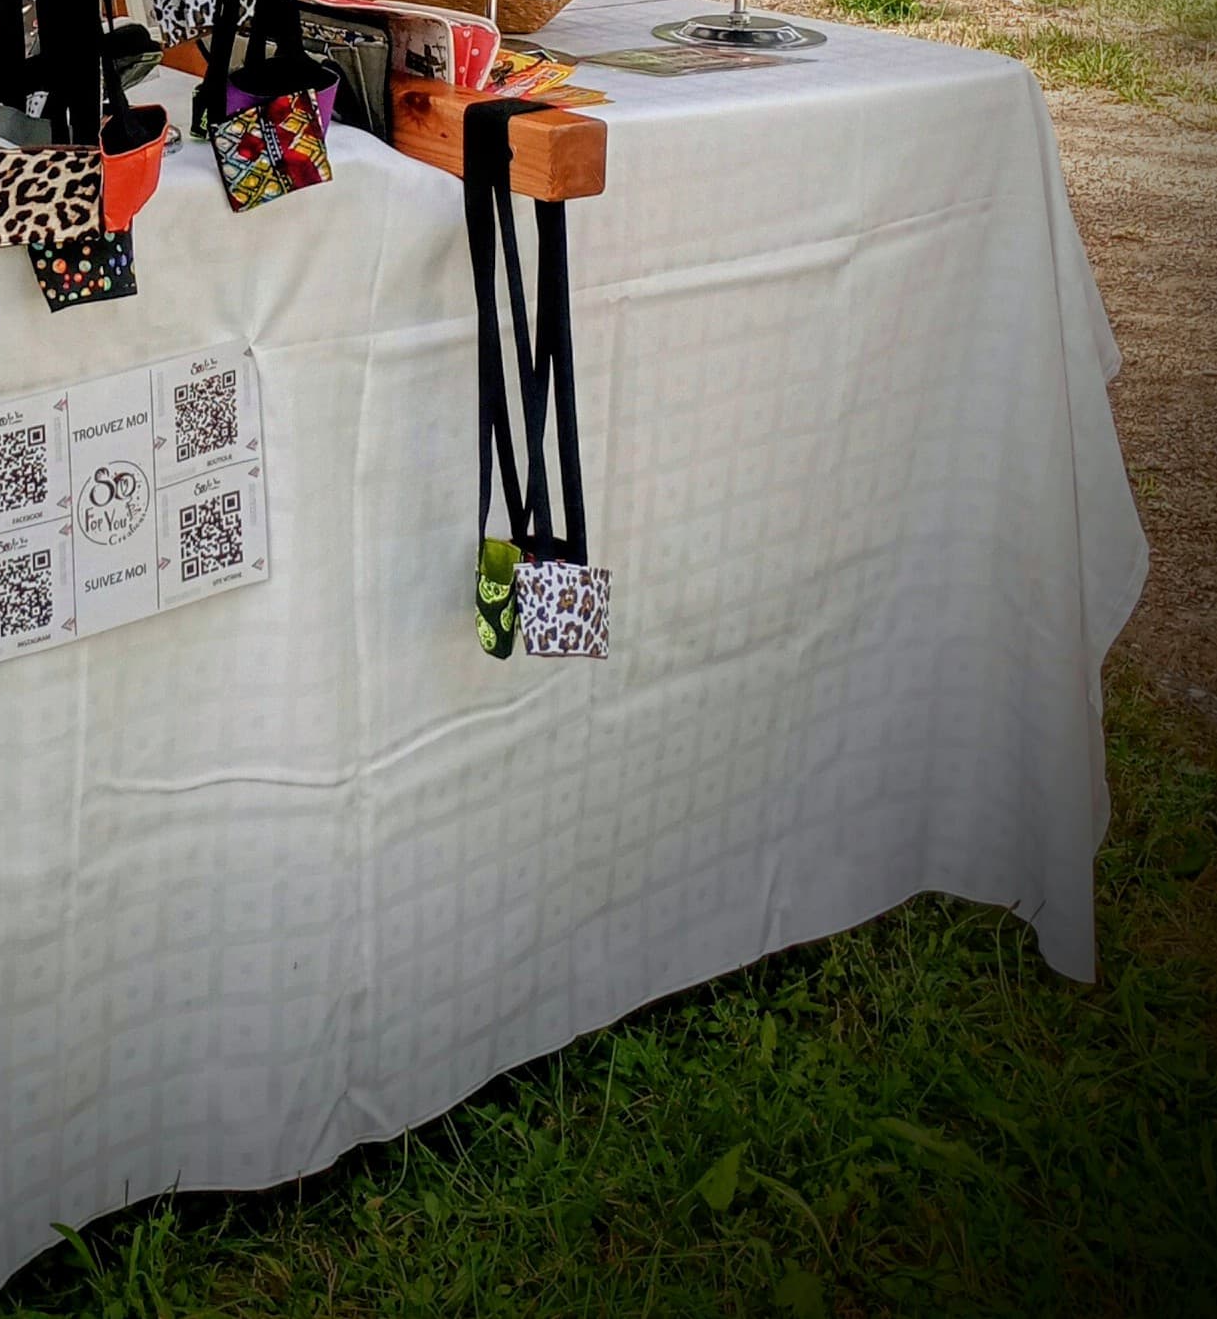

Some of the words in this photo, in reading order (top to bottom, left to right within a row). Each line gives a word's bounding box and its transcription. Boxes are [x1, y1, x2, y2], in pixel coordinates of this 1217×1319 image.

[72, 418, 124, 443] TROUVEZ
[126, 412, 148, 429] MOI
[84, 507, 103, 533] For
[104, 510, 128, 532] You
[84, 571, 123, 593] SUIVEZ
[125, 563, 147, 581] MOI
